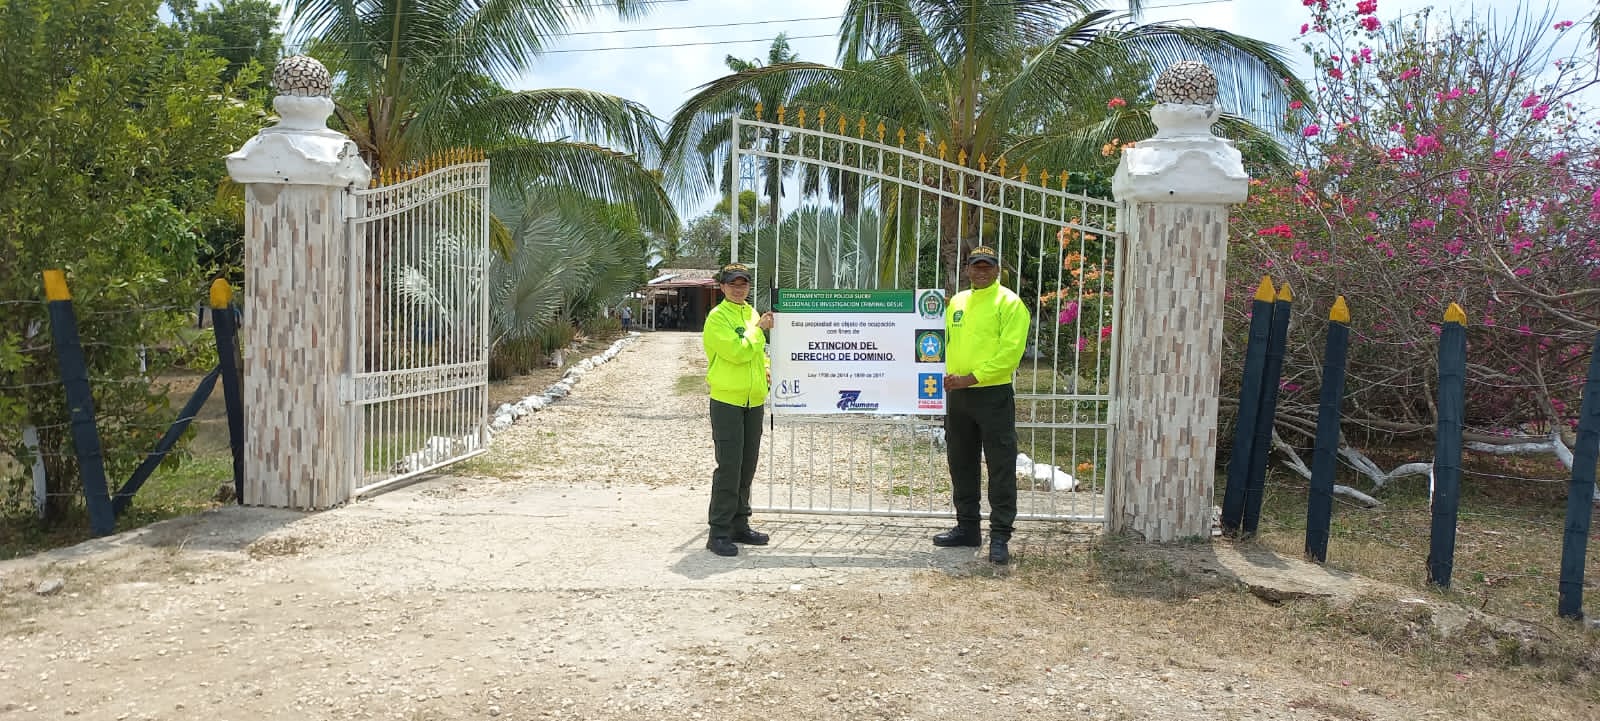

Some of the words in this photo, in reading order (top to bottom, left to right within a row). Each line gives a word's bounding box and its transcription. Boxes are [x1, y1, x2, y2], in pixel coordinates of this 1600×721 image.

[805, 320, 832, 328] propiedad
[841, 320, 858, 328] objeto
[808, 341, 857, 350] EXTINCION
[860, 341, 878, 350] DEL
[791, 352, 836, 361] DERECHO
[838, 352, 851, 361] DE
[853, 352, 896, 361] DOMINIO.
[781, 379, 800, 394] SAE
